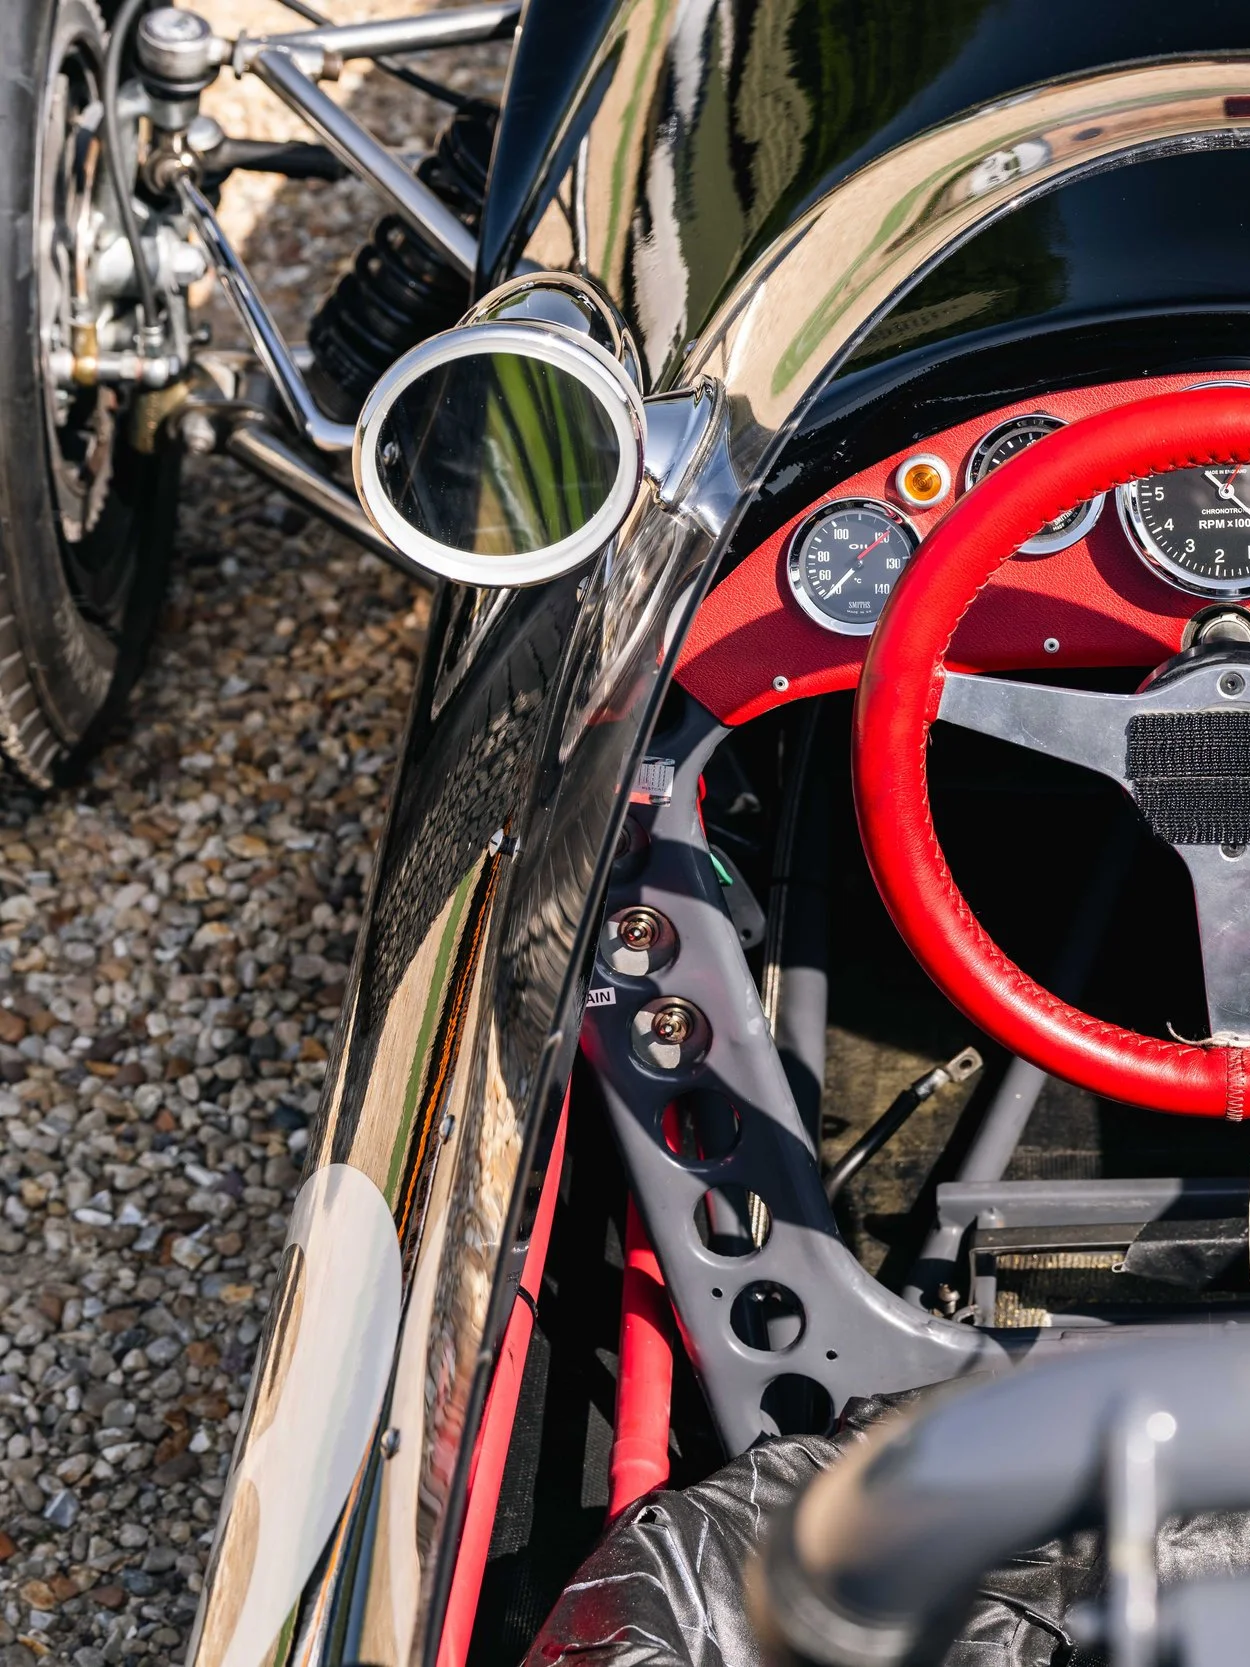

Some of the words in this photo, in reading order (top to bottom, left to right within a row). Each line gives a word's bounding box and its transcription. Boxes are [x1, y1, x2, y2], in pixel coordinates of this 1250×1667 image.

[1154, 486, 1165, 501] 5
[1163, 518, 1174, 531] 4
[1199, 519, 1226, 529] RPM
[833, 529, 849, 540] 100
[1185, 538, 1196, 552] 3
[817, 551, 830, 562] 80
[1214, 548, 1225, 563] 2
[886, 558, 901, 569] 130
[819, 569, 832, 581] 60
[874, 583, 890, 595] 140
[848, 600, 871, 609] SMITHS
[586, 991, 611, 1004] AIN
